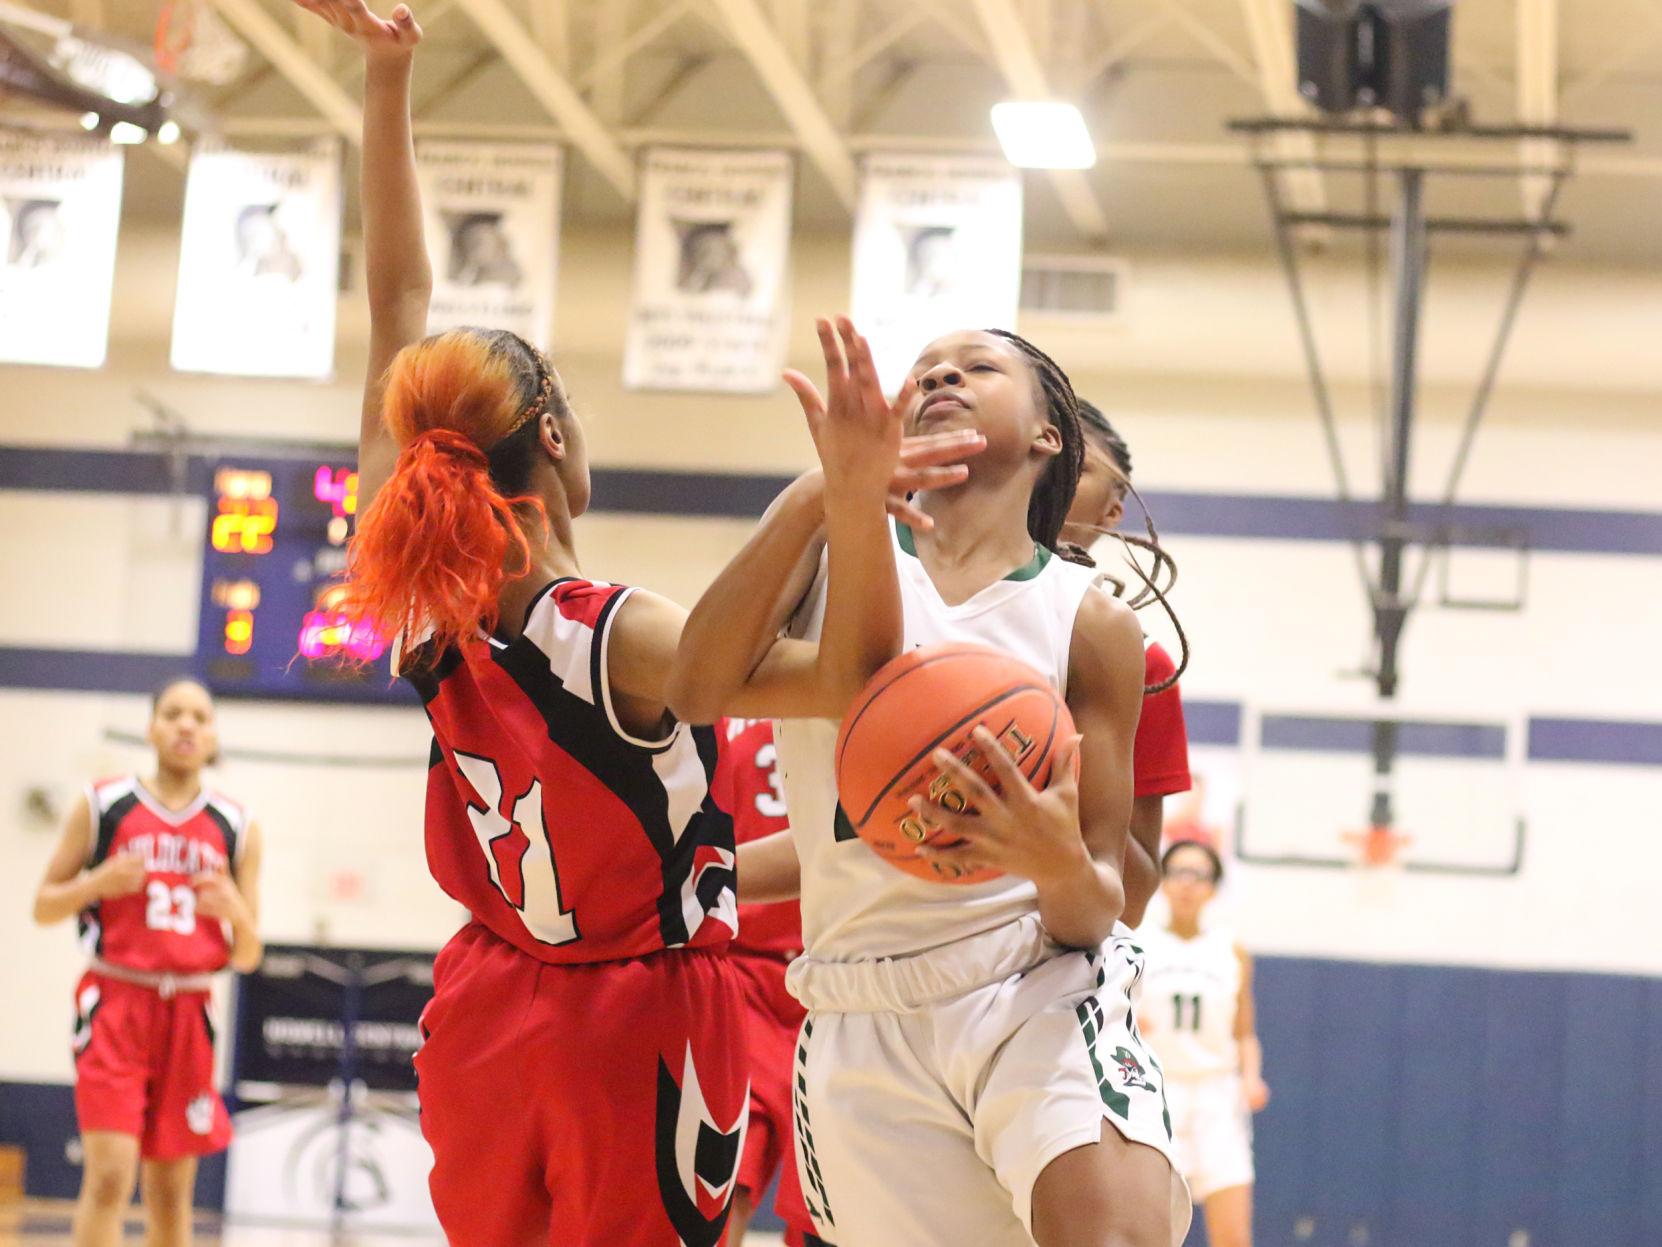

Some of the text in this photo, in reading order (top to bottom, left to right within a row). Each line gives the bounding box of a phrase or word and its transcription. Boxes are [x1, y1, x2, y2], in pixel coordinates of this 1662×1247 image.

[453, 749, 582, 947] 21
[146, 880, 198, 936] 23
[1172, 993, 1201, 1033] 11
